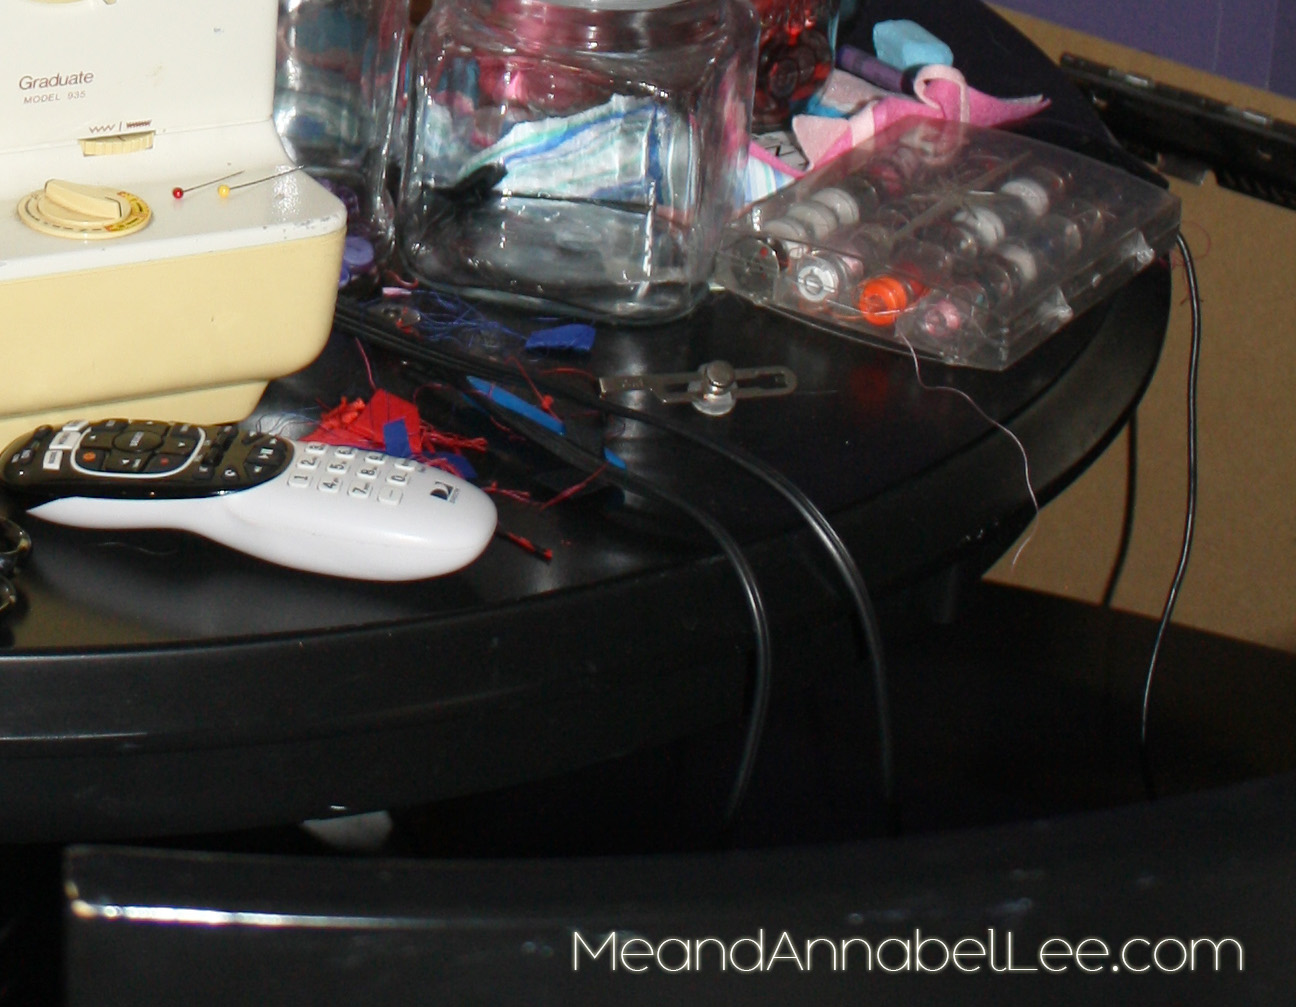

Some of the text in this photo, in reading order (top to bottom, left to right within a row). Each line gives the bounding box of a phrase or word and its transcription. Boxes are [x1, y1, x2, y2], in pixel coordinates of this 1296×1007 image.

[19, 71, 94, 90] Graduate
[23, 90, 86, 104] MODEL 935
